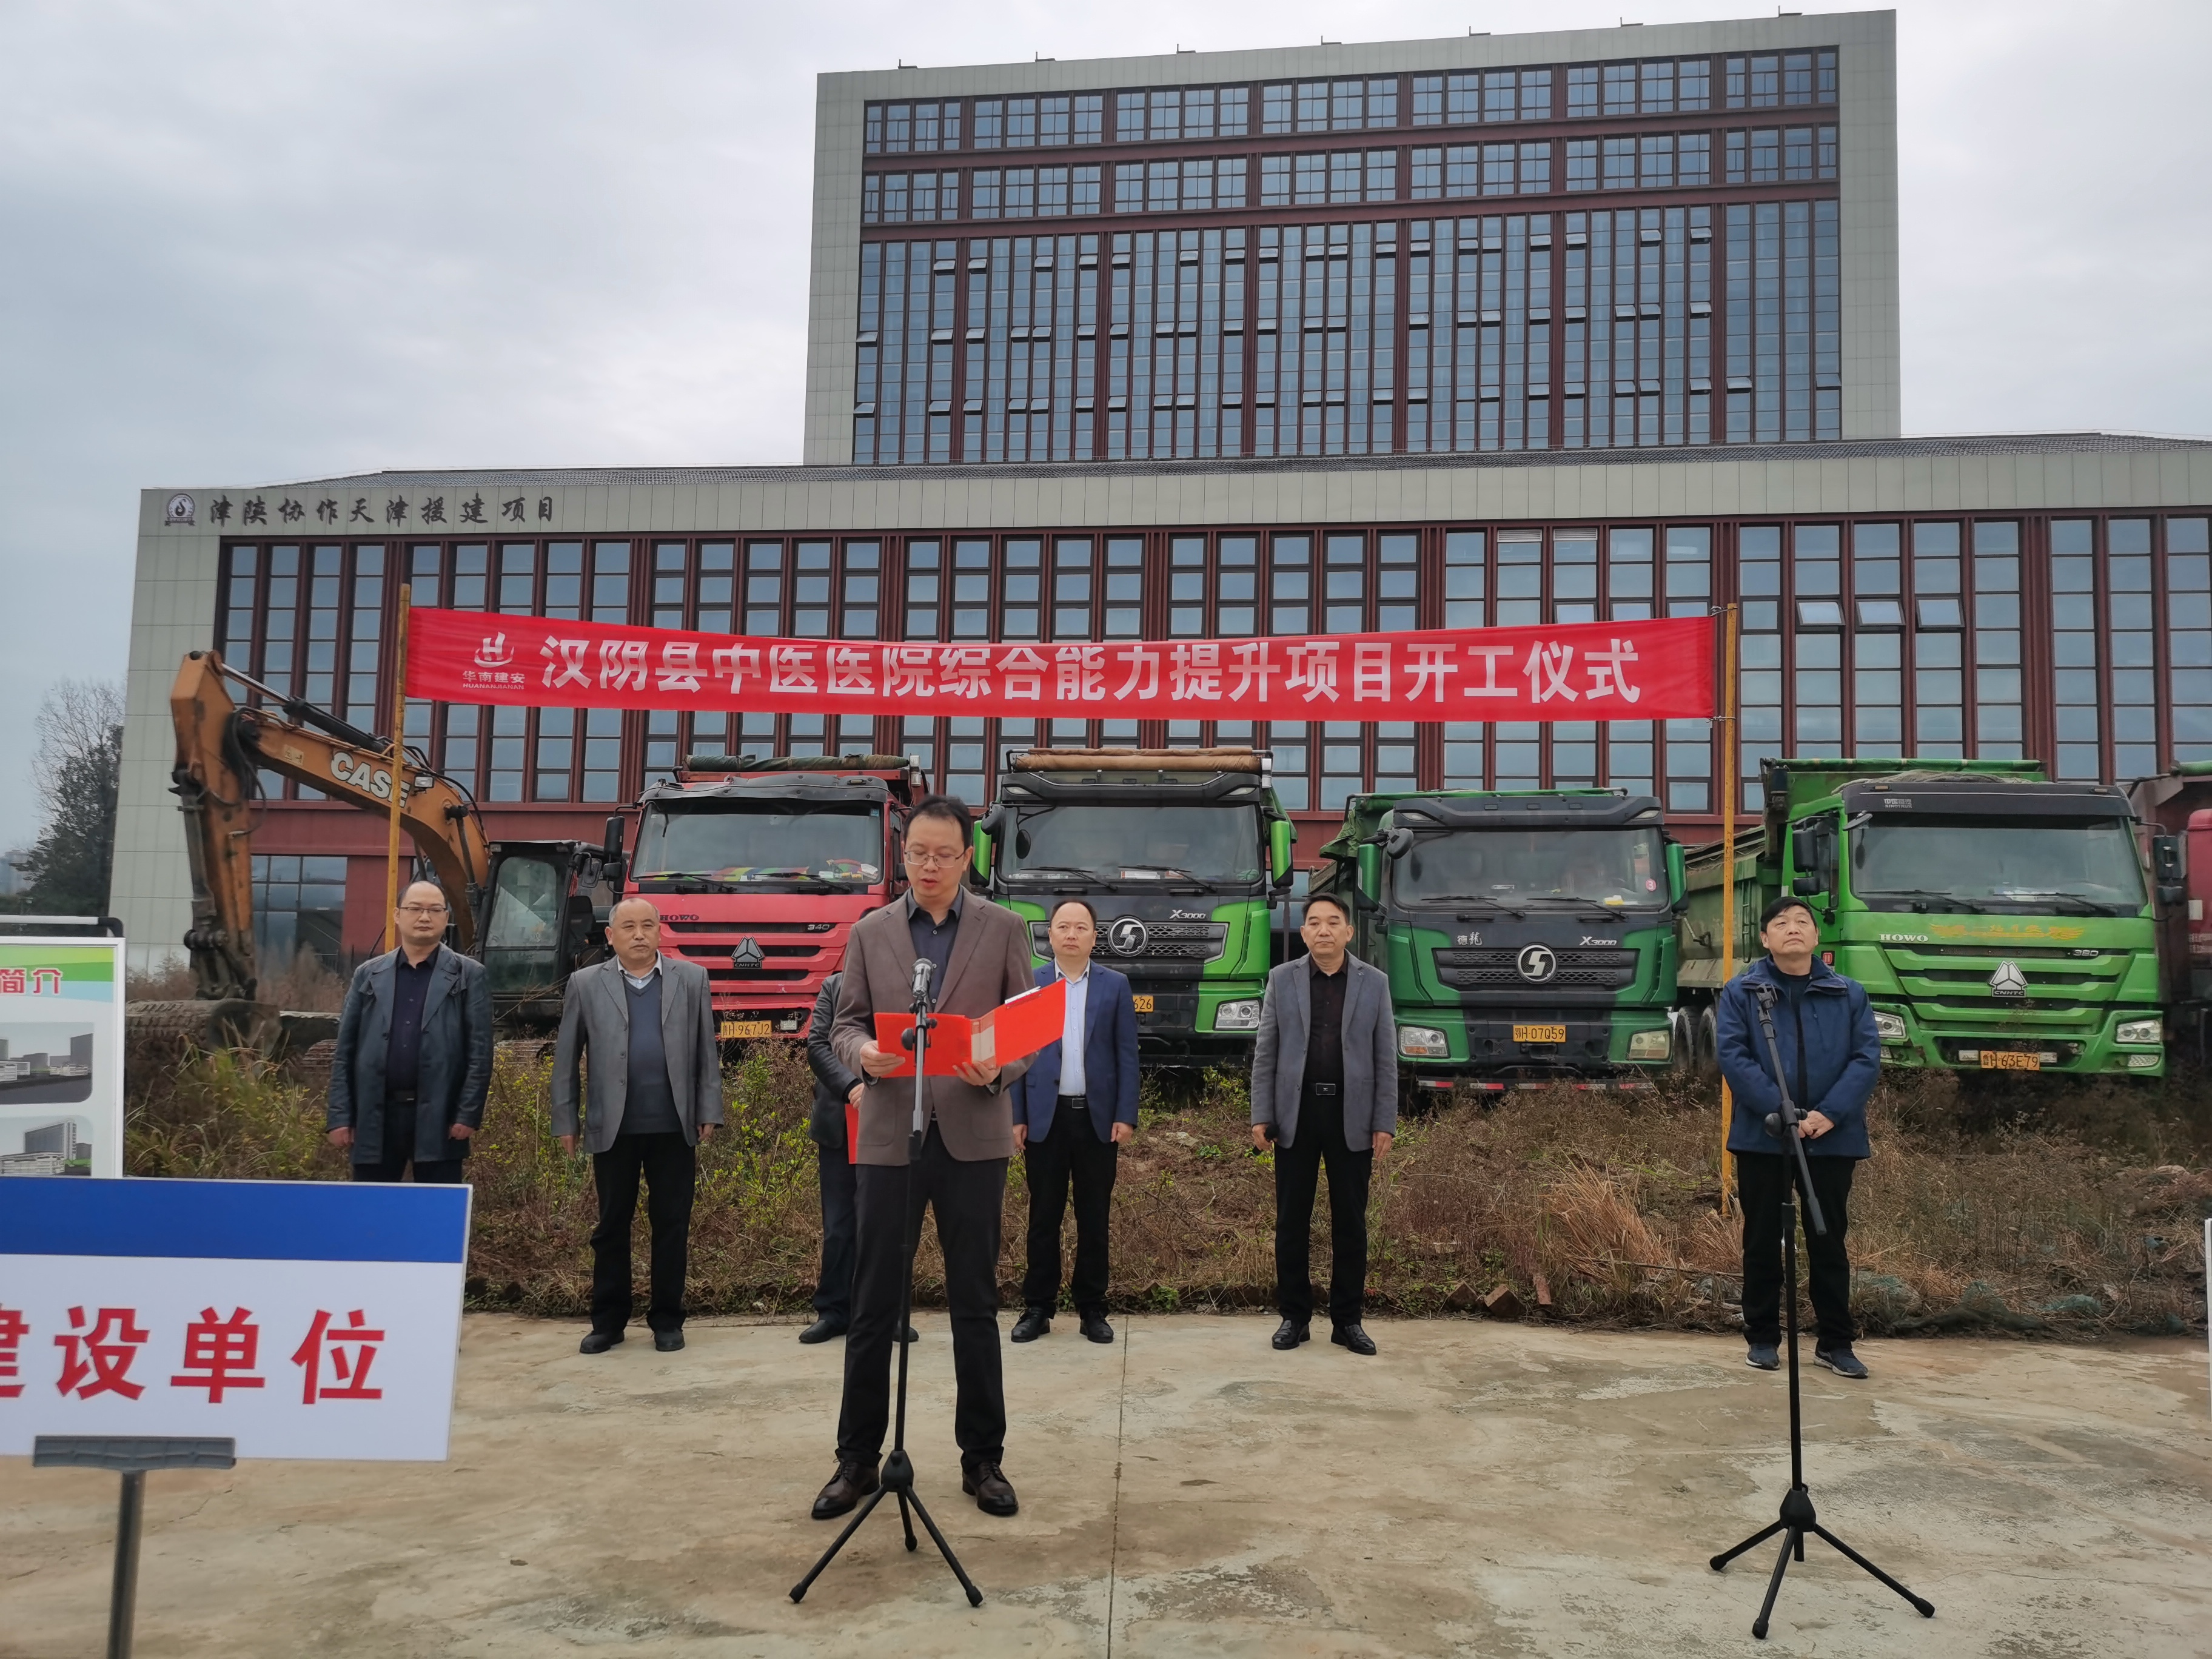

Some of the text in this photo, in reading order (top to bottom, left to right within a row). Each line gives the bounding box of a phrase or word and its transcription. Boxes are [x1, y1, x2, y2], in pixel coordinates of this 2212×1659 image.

[209, 494, 553, 525] 津陕协作天津援建项目
[463, 671, 525, 683] 华南建安
[540, 634, 1641, 703] 汉阴县中医医院综合能力提升项目开工仪式
[330, 751, 411, 808] CASE
[1169, 910, 1206, 919] X3000
[1578, 936, 1617, 946] X3000
[1879, 934, 1929, 942] HOWO
[0, 968, 62, 994] 简介
